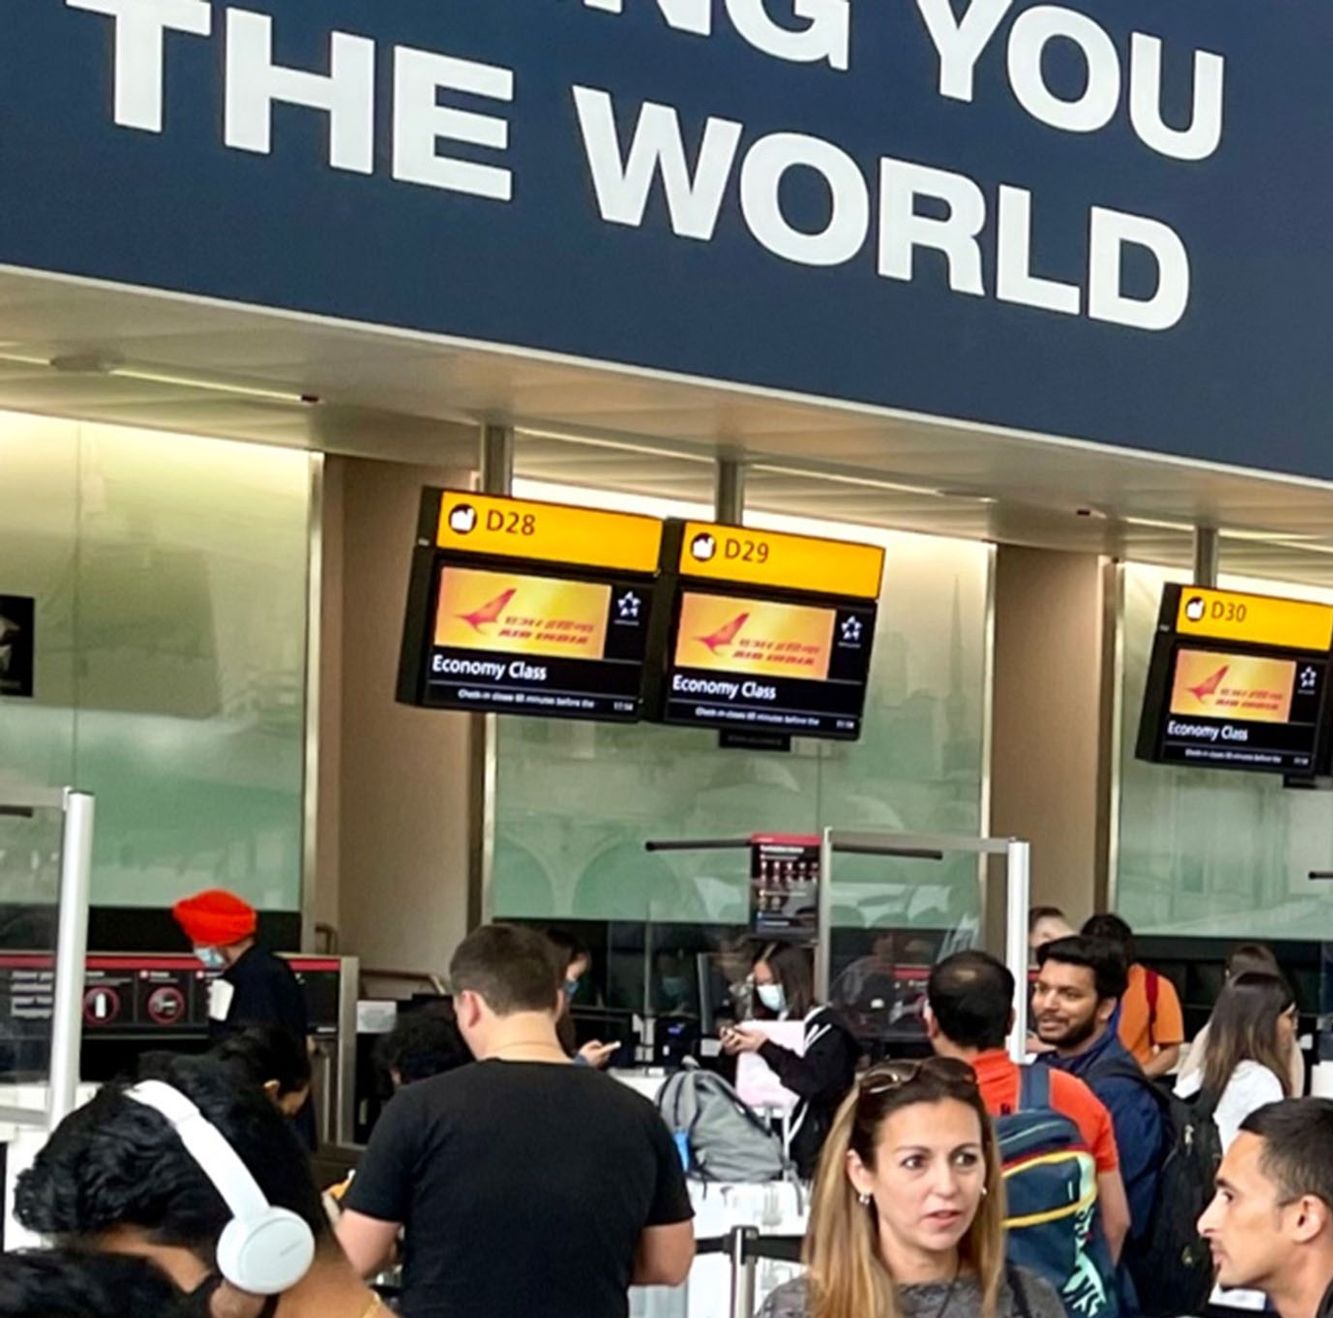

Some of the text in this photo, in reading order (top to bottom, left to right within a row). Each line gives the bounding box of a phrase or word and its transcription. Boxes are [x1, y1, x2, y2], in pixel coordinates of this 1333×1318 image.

[889, 0, 1225, 161] YOU
[66, 0, 1191, 332] THE WORLD
[487, 510, 536, 536] D28
[725, 539, 770, 563] D29
[1210, 600, 1247, 621] D30
[432, 653, 548, 681] Economy Class
[672, 675, 776, 700] Economy Class
[1167, 720, 1248, 742] Economy Class
